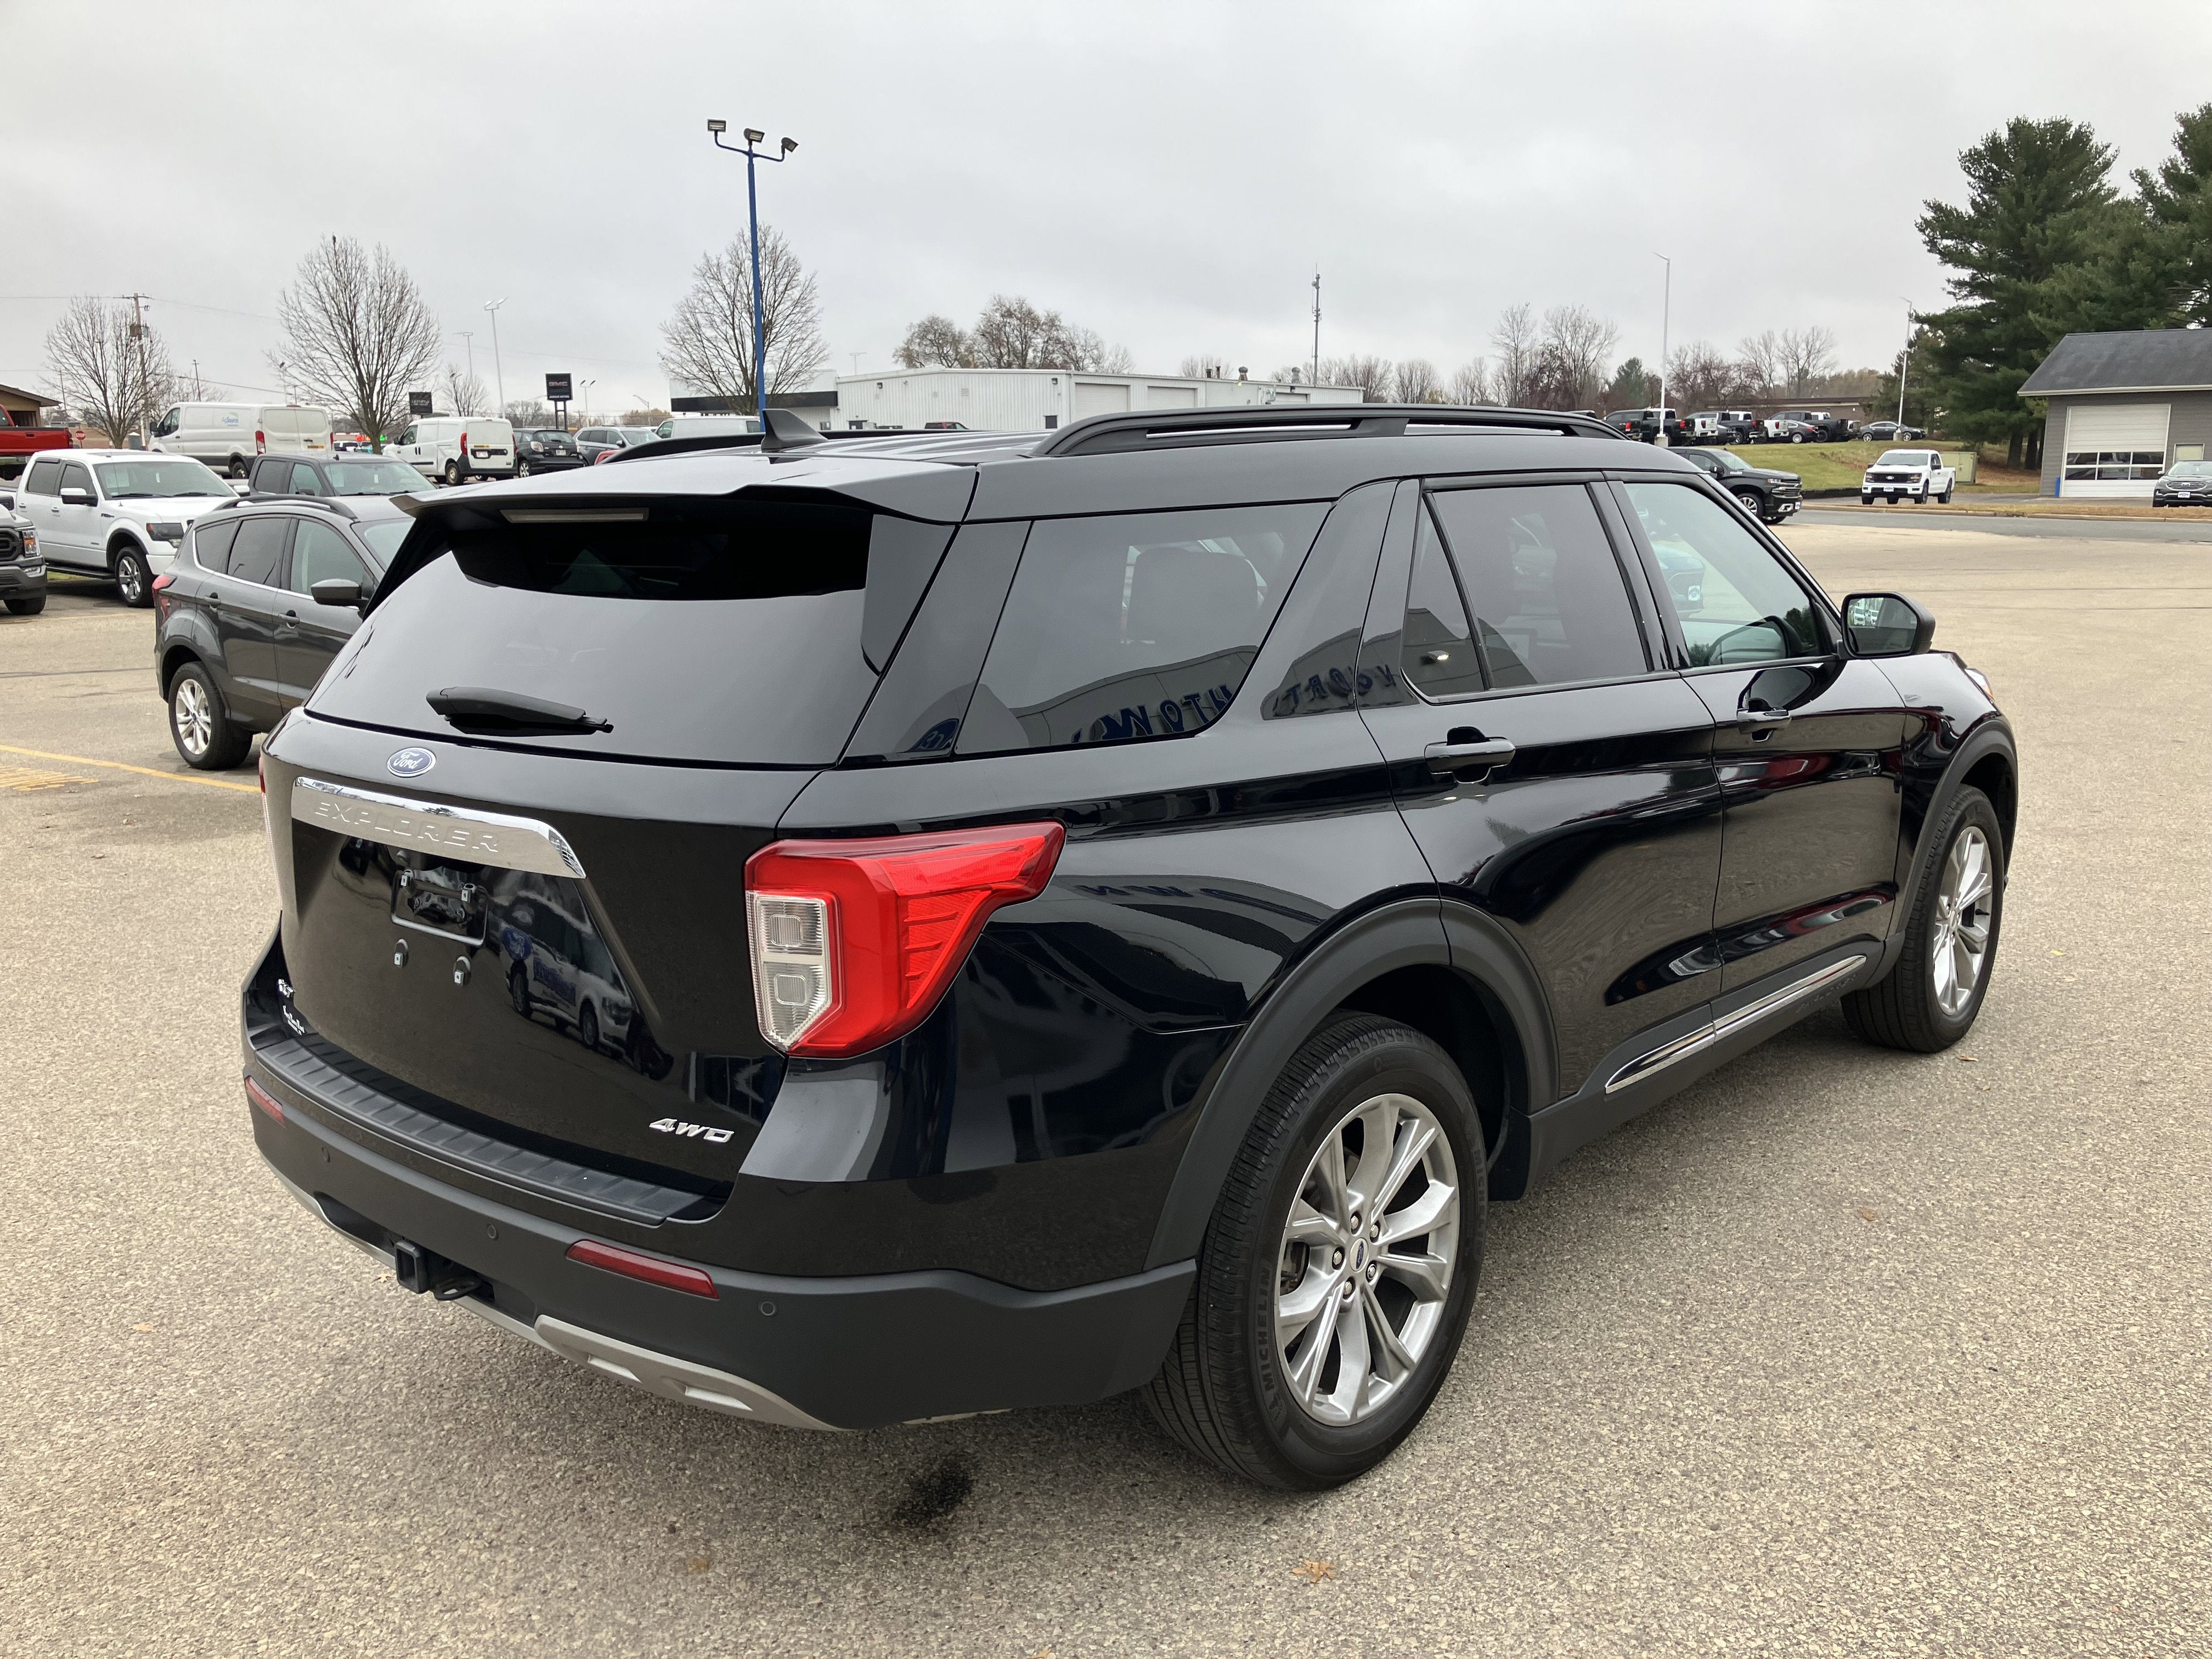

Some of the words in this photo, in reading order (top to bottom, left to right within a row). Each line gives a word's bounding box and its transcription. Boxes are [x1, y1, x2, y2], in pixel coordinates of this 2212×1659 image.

[393, 752, 424, 769] Ford
[315, 802, 499, 853] EXPLORER
[649, 1118, 735, 1143] 4WD
[1257, 1267, 1275, 1391] MICHELIN
